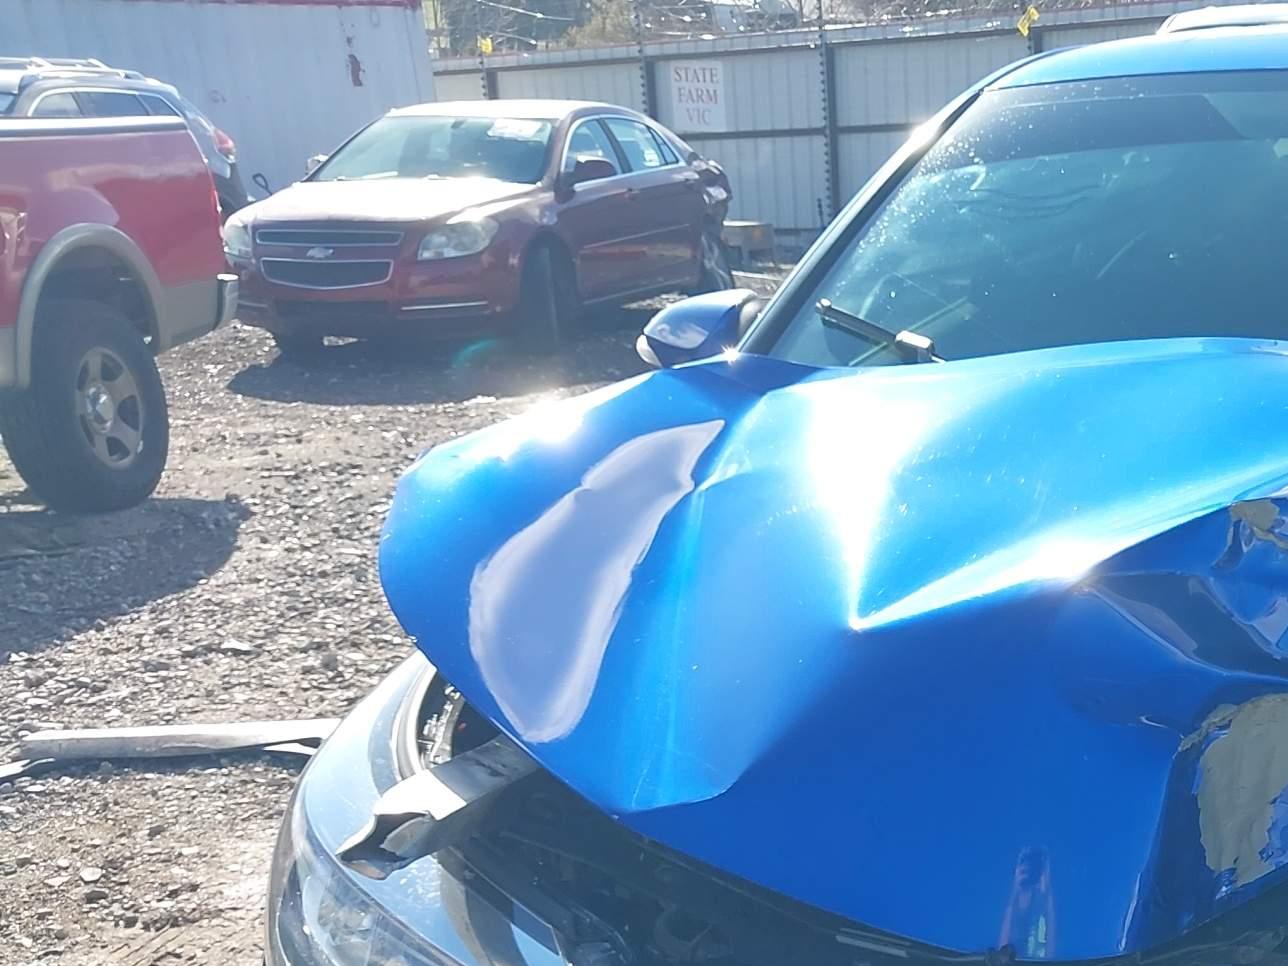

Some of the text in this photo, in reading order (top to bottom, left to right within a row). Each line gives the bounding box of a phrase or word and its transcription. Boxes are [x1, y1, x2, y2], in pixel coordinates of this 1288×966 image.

[674, 66, 720, 84] STATE
[677, 87, 719, 105] FARM
[686, 108, 712, 125] VIC
